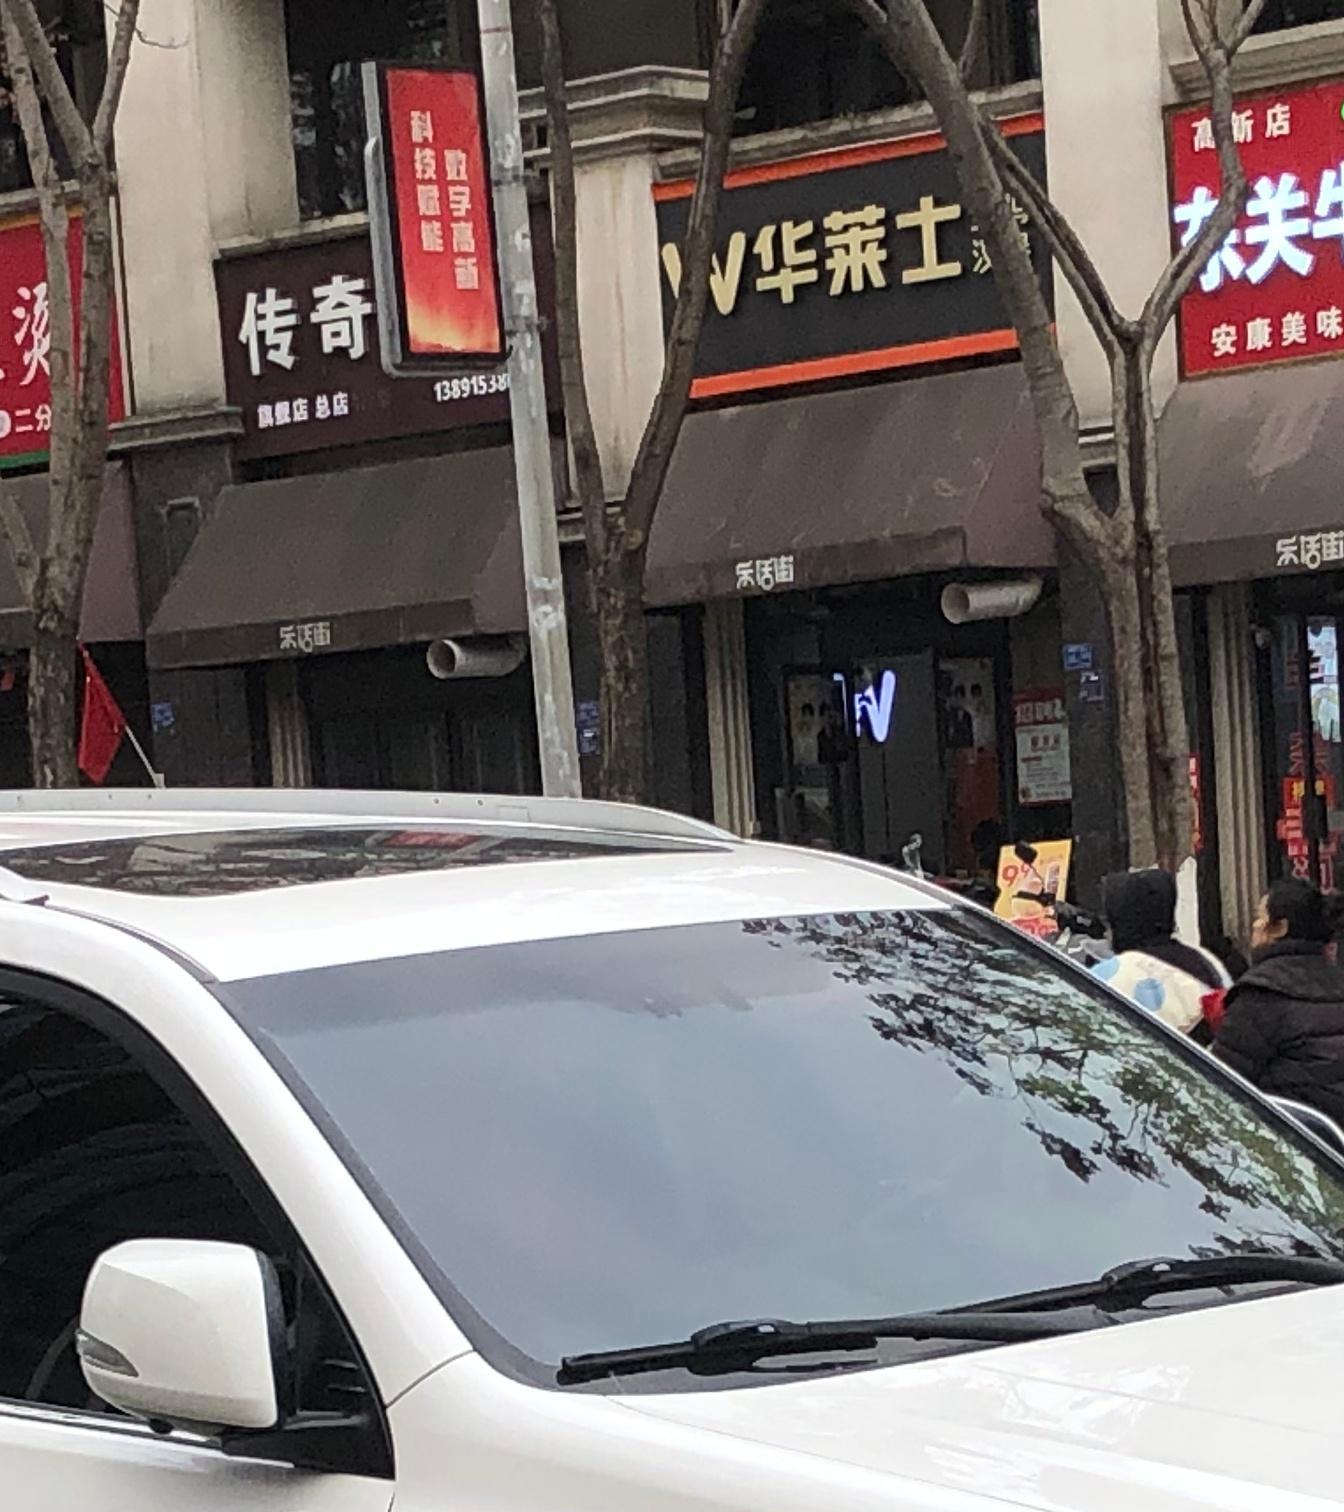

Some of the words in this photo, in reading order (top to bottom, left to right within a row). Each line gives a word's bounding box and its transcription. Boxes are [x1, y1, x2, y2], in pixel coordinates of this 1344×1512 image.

[410, 110, 444, 252] 科技赋能
[444, 149, 479, 290] 数字高新
[754, 196, 962, 305] 华莱士
[238, 274, 374, 377] 传奇
[1210, 306, 1344, 357] 安康美味
